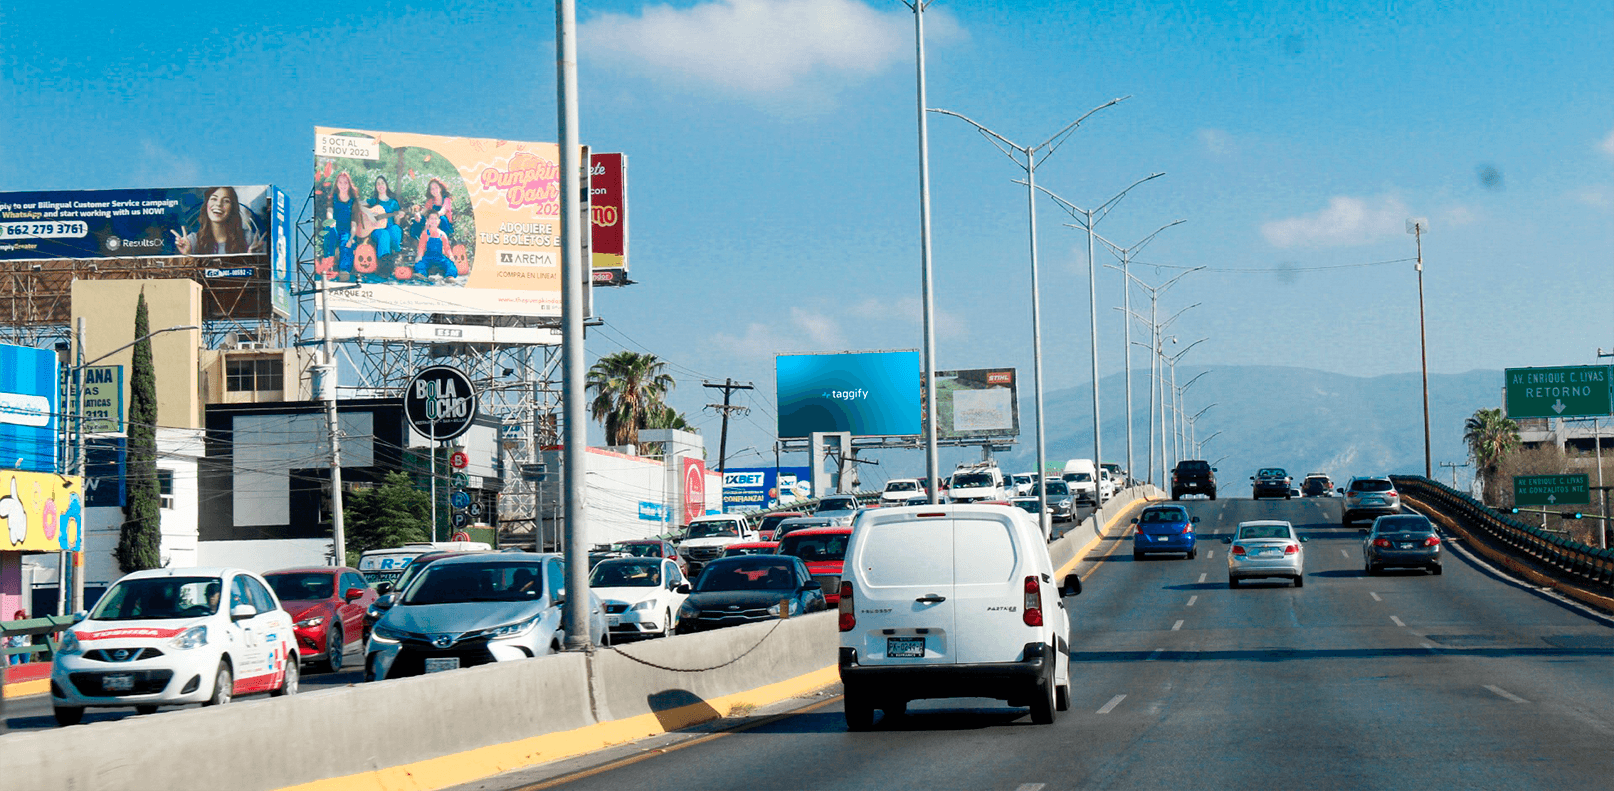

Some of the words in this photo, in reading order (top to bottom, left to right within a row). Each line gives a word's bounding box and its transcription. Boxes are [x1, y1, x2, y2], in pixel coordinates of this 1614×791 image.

[329, 137, 345, 146] OCT
[329, 146, 347, 155] NOV
[350, 148, 369, 156] 2023
[0, 203, 12, 211] ply
[38, 201, 72, 210] Bilingual
[73, 200, 110, 208] Customer
[111, 199, 140, 207] Service
[141, 199, 179, 208] campaign
[536, 203, 560, 215] 202
[2, 211, 43, 219] WhatsApp
[80, 209, 111, 218] working
[112, 208, 130, 216] with
[142, 207, 165, 215] NOW!
[7, 225, 29, 235] 662
[32, 224, 54, 234] 279
[57, 224, 83, 234] 3761
[499, 221, 552, 236] ADQUIERE
[122, 238, 165, 247] ResultsCX
[480, 232, 500, 245] TUS
[503, 234, 551, 247] BOLETOS
[553, 235, 561, 247] E
[515, 253, 552, 264] AREMA
[329, 290, 359, 298] PARQUE
[1513, 373, 1524, 384] AV.
[1528, 372, 1565, 384] ENRIQUE
[1570, 372, 1577, 382] C.
[1580, 371, 1604, 382] LIVAS
[416, 378, 457, 399] BOLA
[832, 387, 869, 401] taggify
[1526, 386, 1591, 398] RETORNO
[426, 397, 467, 419] OCHO
[1528, 477, 1556, 486] ENRIQUE
[1566, 476, 1584, 484] LIVAS
[1529, 486, 1569, 494] GONZALITOS
[93, 629, 159, 638] TOSHIBA
